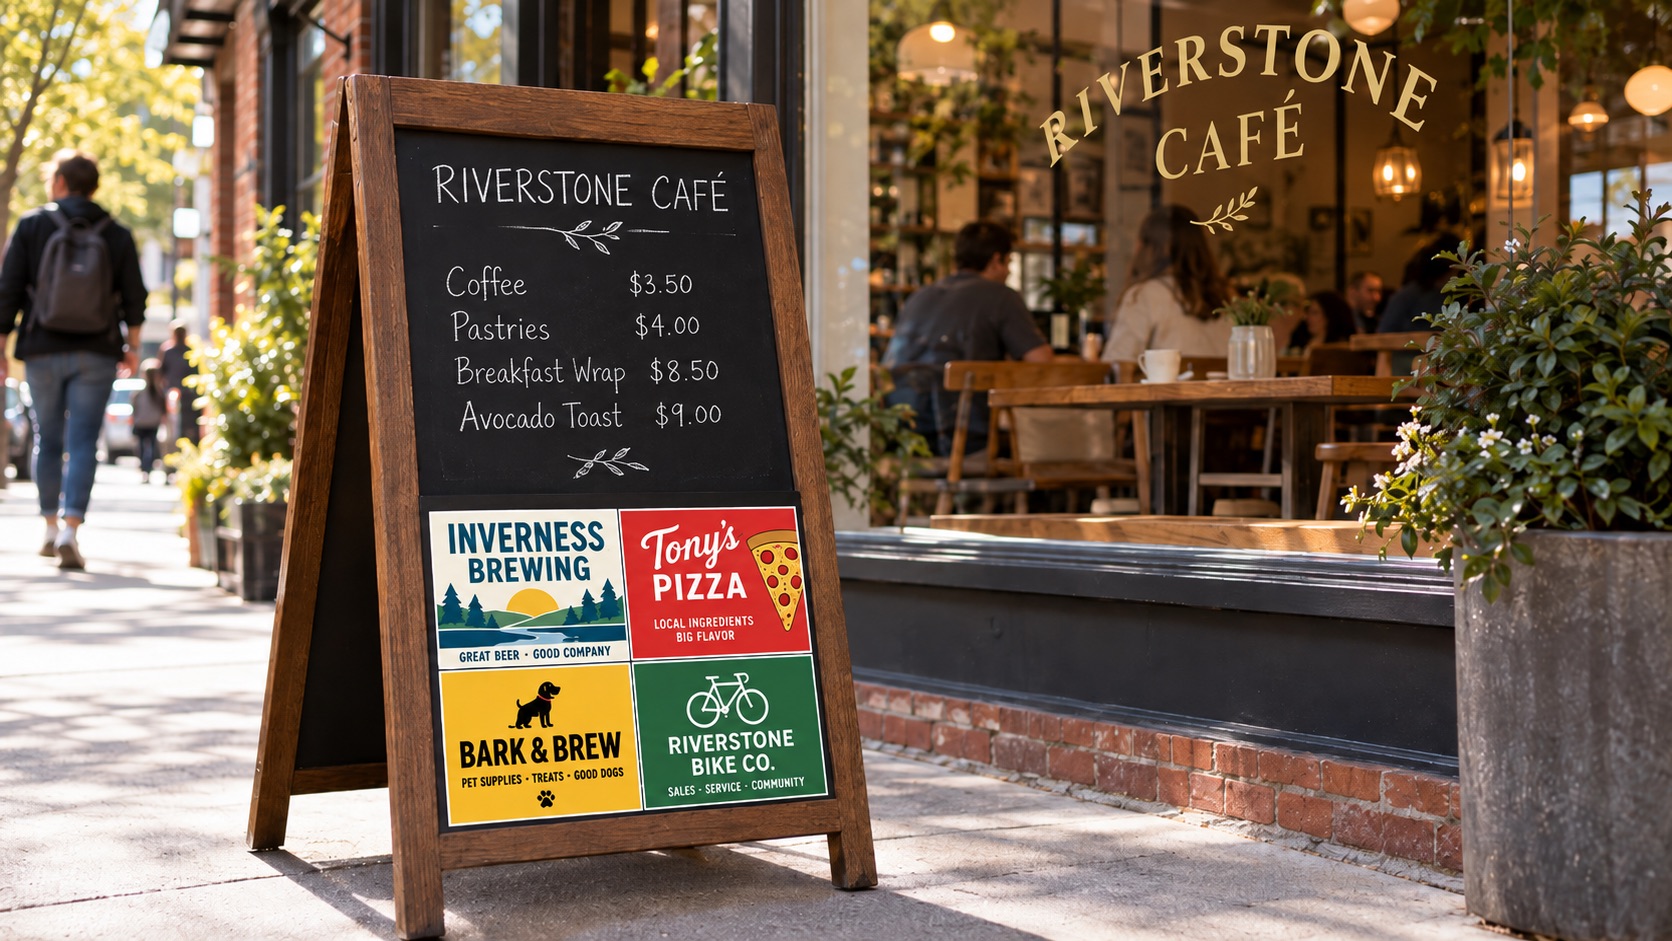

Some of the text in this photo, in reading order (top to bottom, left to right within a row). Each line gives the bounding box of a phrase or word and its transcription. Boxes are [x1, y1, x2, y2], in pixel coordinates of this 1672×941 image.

[1040, 24, 1438, 168] RIVERSTONE
[1155, 89, 1305, 180] CAFÉ
[432, 164, 728, 212] RIVERSTONE CAFÉ
[446, 266, 692, 301] Coffee $3.50
[451, 311, 699, 341] Pastries $4.00
[455, 357, 719, 394] Breakfast Wrap $8.50
[460, 400, 722, 431] Avocado Toast $9.00
[448, 521, 605, 554] INVERNESS
[640, 520, 740, 570] Tony's
[468, 556, 591, 584] BREWING
[653, 572, 747, 601] PIZZA
[654, 616, 754, 630] LOCAL INGREDIENTS
[676, 630, 735, 642] BIG FLAVOR
[459, 645, 611, 663] GREAT BEER GOOD COMPANY
[459, 731, 621, 769] BARK & BREW
[668, 729, 794, 754] RIVERSTONE
[461, 767, 624, 788] PET SUPPLIES TREATS GOOD DOGS
[691, 754, 775, 776] BIKE CO.
[668, 777, 805, 797] SALES SERVICE COMMUNITY
